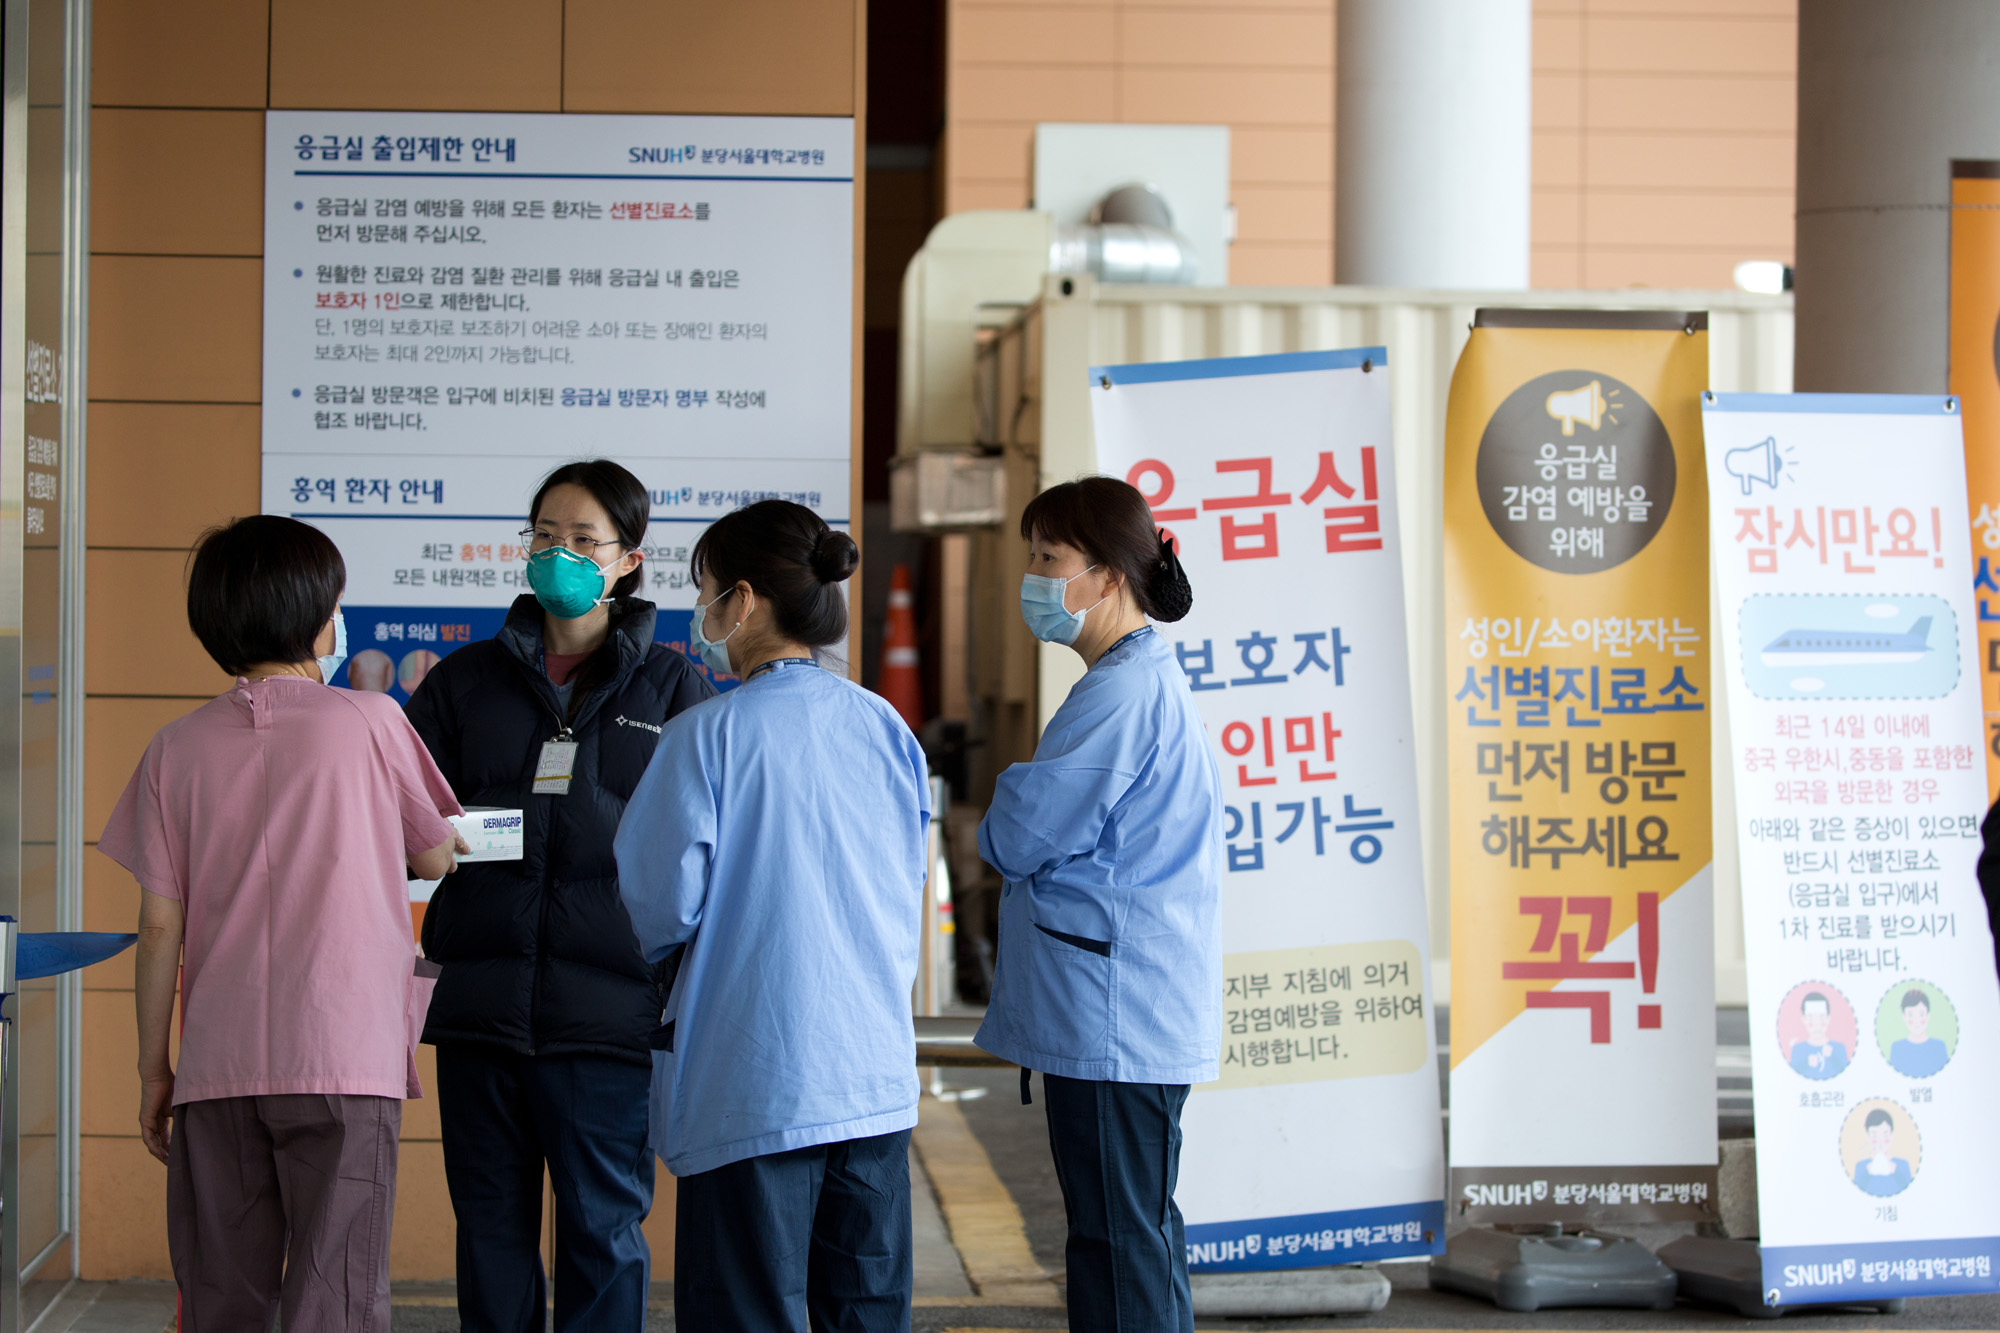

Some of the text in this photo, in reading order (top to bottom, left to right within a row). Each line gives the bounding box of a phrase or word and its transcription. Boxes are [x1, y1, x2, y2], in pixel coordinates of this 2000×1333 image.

[295, 135, 515, 162] 응급실 출입제한 안내
[629, 147, 682, 163] SNUH
[701, 148, 824, 165] 분당서울대학교병원
[316, 198, 710, 220] 응급실 감염 예방을 위해 모든 환자는 선별진료소를
[317, 224, 486, 243] 먼저 방문해 주십시오.
[316, 265, 739, 288] 원활한 진료와 감염 질환 관리를 위해 응급실 내 출입은
[316, 292, 529, 311] 보호자 1인으로 제한합니다.
[315, 318, 767, 340] 단, 1명의 보호자로 보조하기 어려운 소아 또는 장애인 환자의
[315, 344, 573, 364] 보호자는 최대 2인까지 가능합니다.
[314, 385, 766, 409] 응급실 방문객은 입구에 비치된 응급실 방문자 명부 작성에
[315, 411, 426, 430] 협조 바랍니다.
[1534, 443, 1616, 481] 응급실
[291, 477, 443, 504] 홍역 환자 안내
[1126, 446, 1384, 562] 응급실
[1501, 484, 1653, 524] 감염 예방을
[422, 544, 453, 561] 최근
[460, 543, 491, 562] 홍역
[1549, 526, 1603, 558] 위해
[1735, 506, 1944, 574] 잠시만요!
[393, 569, 425, 586] 모든
[433, 568, 496, 587] 내원객은
[374, 622, 472, 642] 홍역 의심 발진
[1459, 615, 1701, 660] 성인/소아환자는
[1176, 627, 1351, 692] 보호자
[1454, 665, 1705, 727] 선별진료소
[1776, 714, 1930, 739] 최근 14일 이내에
[1204, 712, 1343, 788] 인만
[1745, 748, 1776, 772] 중국
[1914, 745, 1974, 770] 포함한
[1477, 740, 1686, 804] 먼저 방문
[1775, 778, 1940, 805] 외국을 방문한 경우
[483, 817, 521, 828] DERMAGRIP
[1750, 814, 1978, 842] 아래와 같은 증상이 있으면
[1482, 815, 1680, 869] 해주세요
[1784, 849, 1941, 874] 반드시 선별진료소
[1789, 881, 1938, 908] (응급실 입구)에서
[1780, 913, 1955, 940] 1차 진료를 받으시기
[1501, 890, 1663, 1044] 꼭!
[1827, 947, 1907, 972] 바랍니다.
[1222, 961, 1409, 1001] 지부 지침에 의거
[1355, 994, 1423, 1022] 위하여
[1462, 1181, 1533, 1207] SNUH
[1553, 1182, 1708, 1205] 분당서울대학교병원
[1876, 1205, 1898, 1222] 기침
[1266, 1222, 1422, 1257] 분당서울대학교병원
[1784, 1263, 1843, 1287] SNUH
[1860, 1256, 1990, 1282] 분당서울대학교병원
